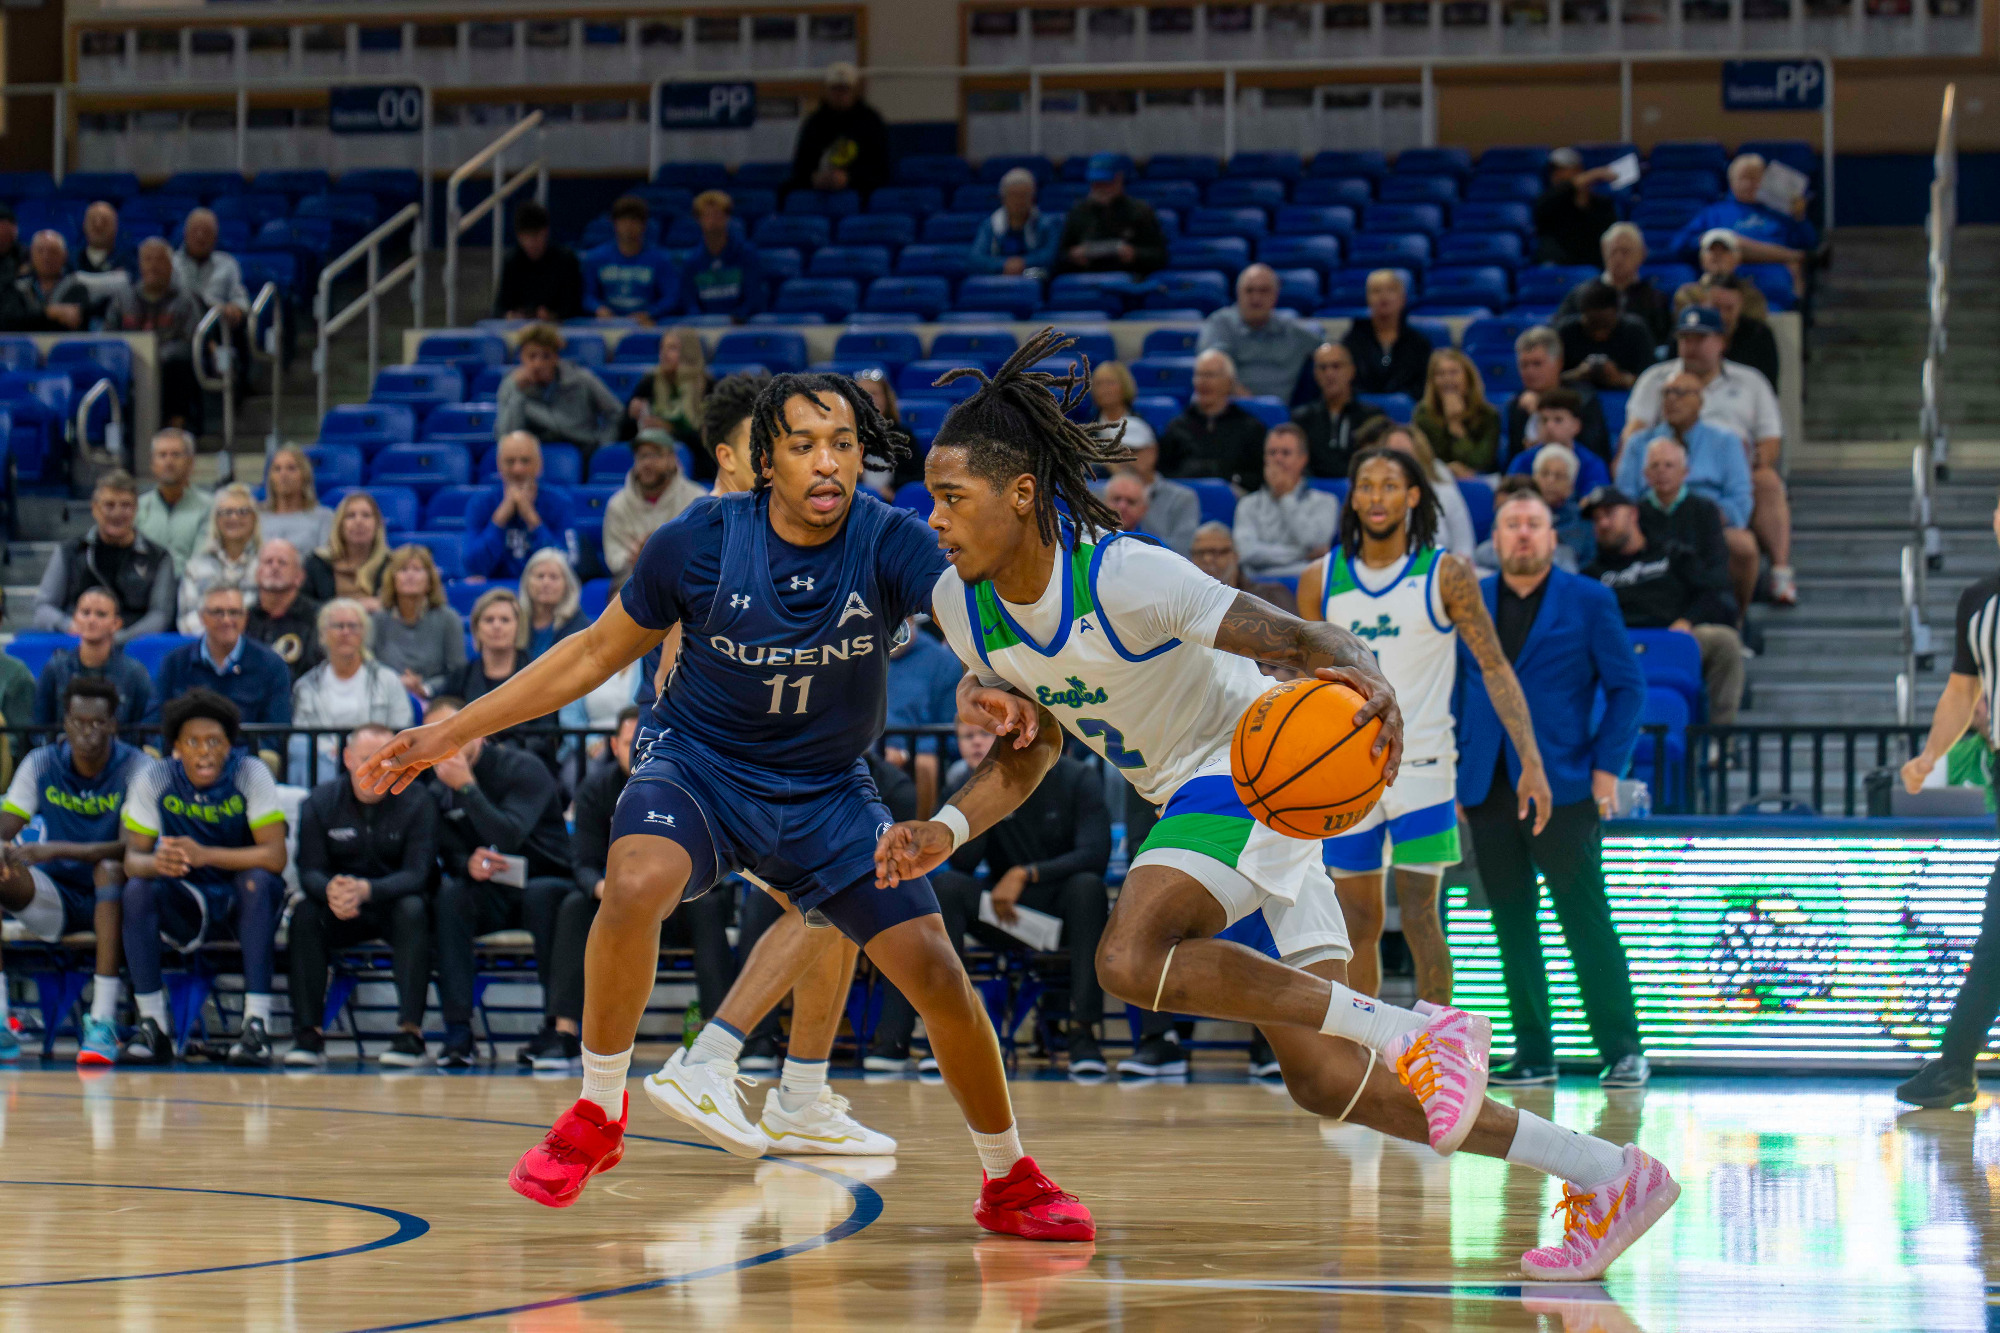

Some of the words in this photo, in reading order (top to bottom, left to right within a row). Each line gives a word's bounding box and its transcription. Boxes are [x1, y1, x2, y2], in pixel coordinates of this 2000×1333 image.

[1777, 65, 1820, 101] PP
[709, 85, 750, 119] PP
[710, 635, 874, 666] QUEENS
[762, 673, 815, 715] 11
[1036, 676, 1108, 709] Eagles
[1076, 718, 1147, 769] 2
